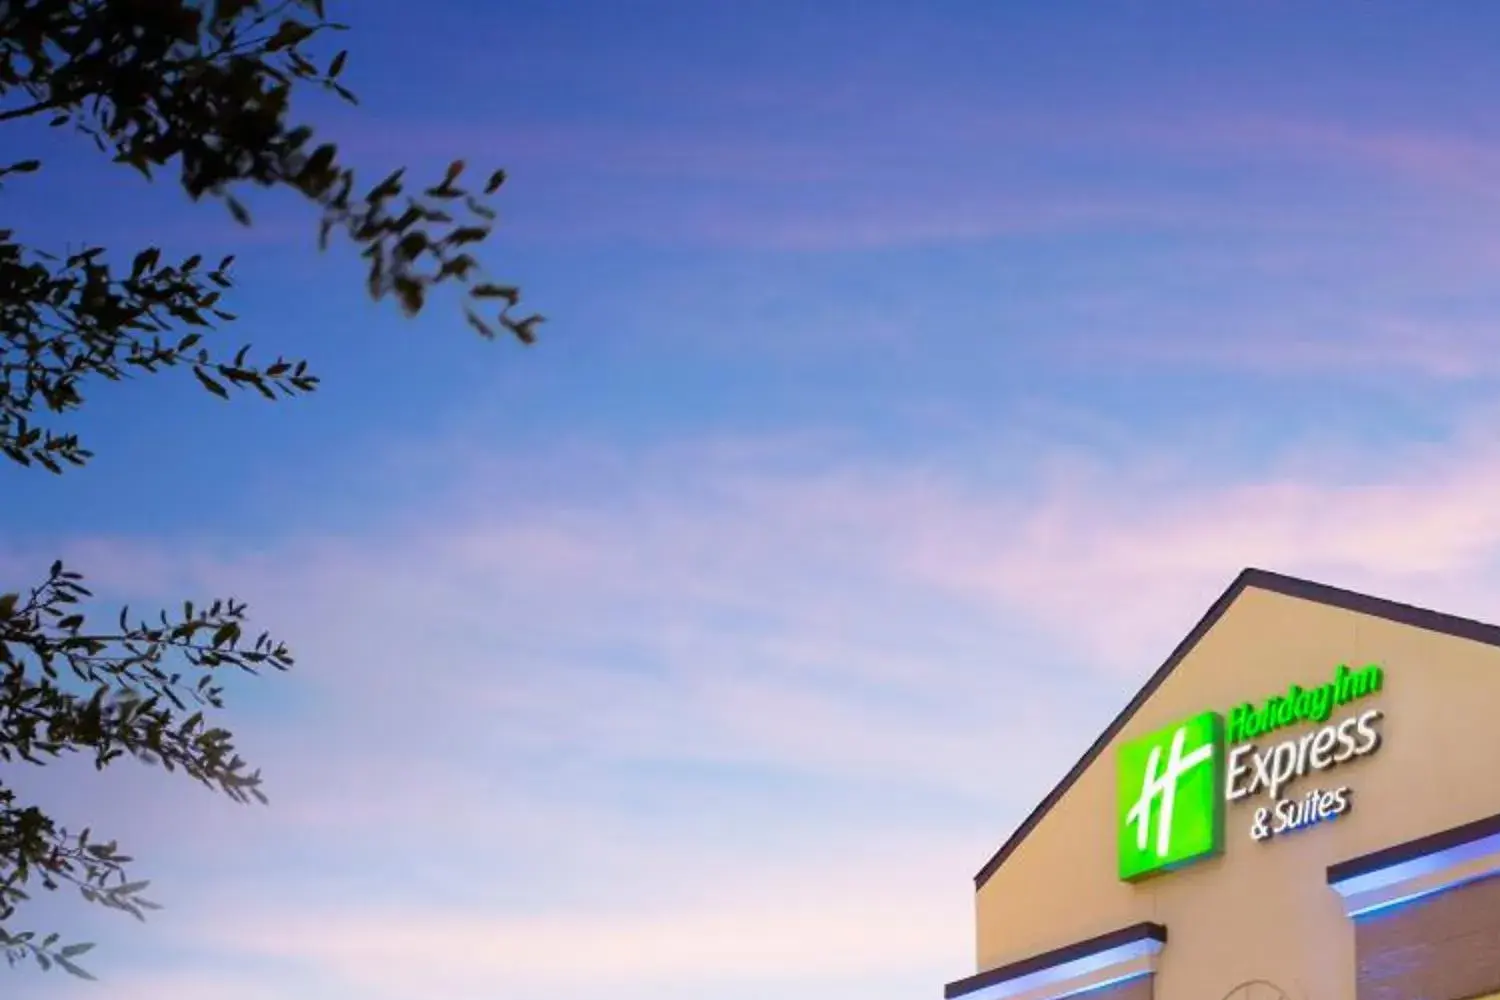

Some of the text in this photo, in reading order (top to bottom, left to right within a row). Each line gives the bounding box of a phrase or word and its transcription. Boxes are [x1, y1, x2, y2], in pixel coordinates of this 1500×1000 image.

[1226, 663, 1384, 743] Holiday Inn
[1126, 726, 1213, 859] H
[1225, 709, 1380, 800] Express
[1250, 786, 1349, 840] & Suites
